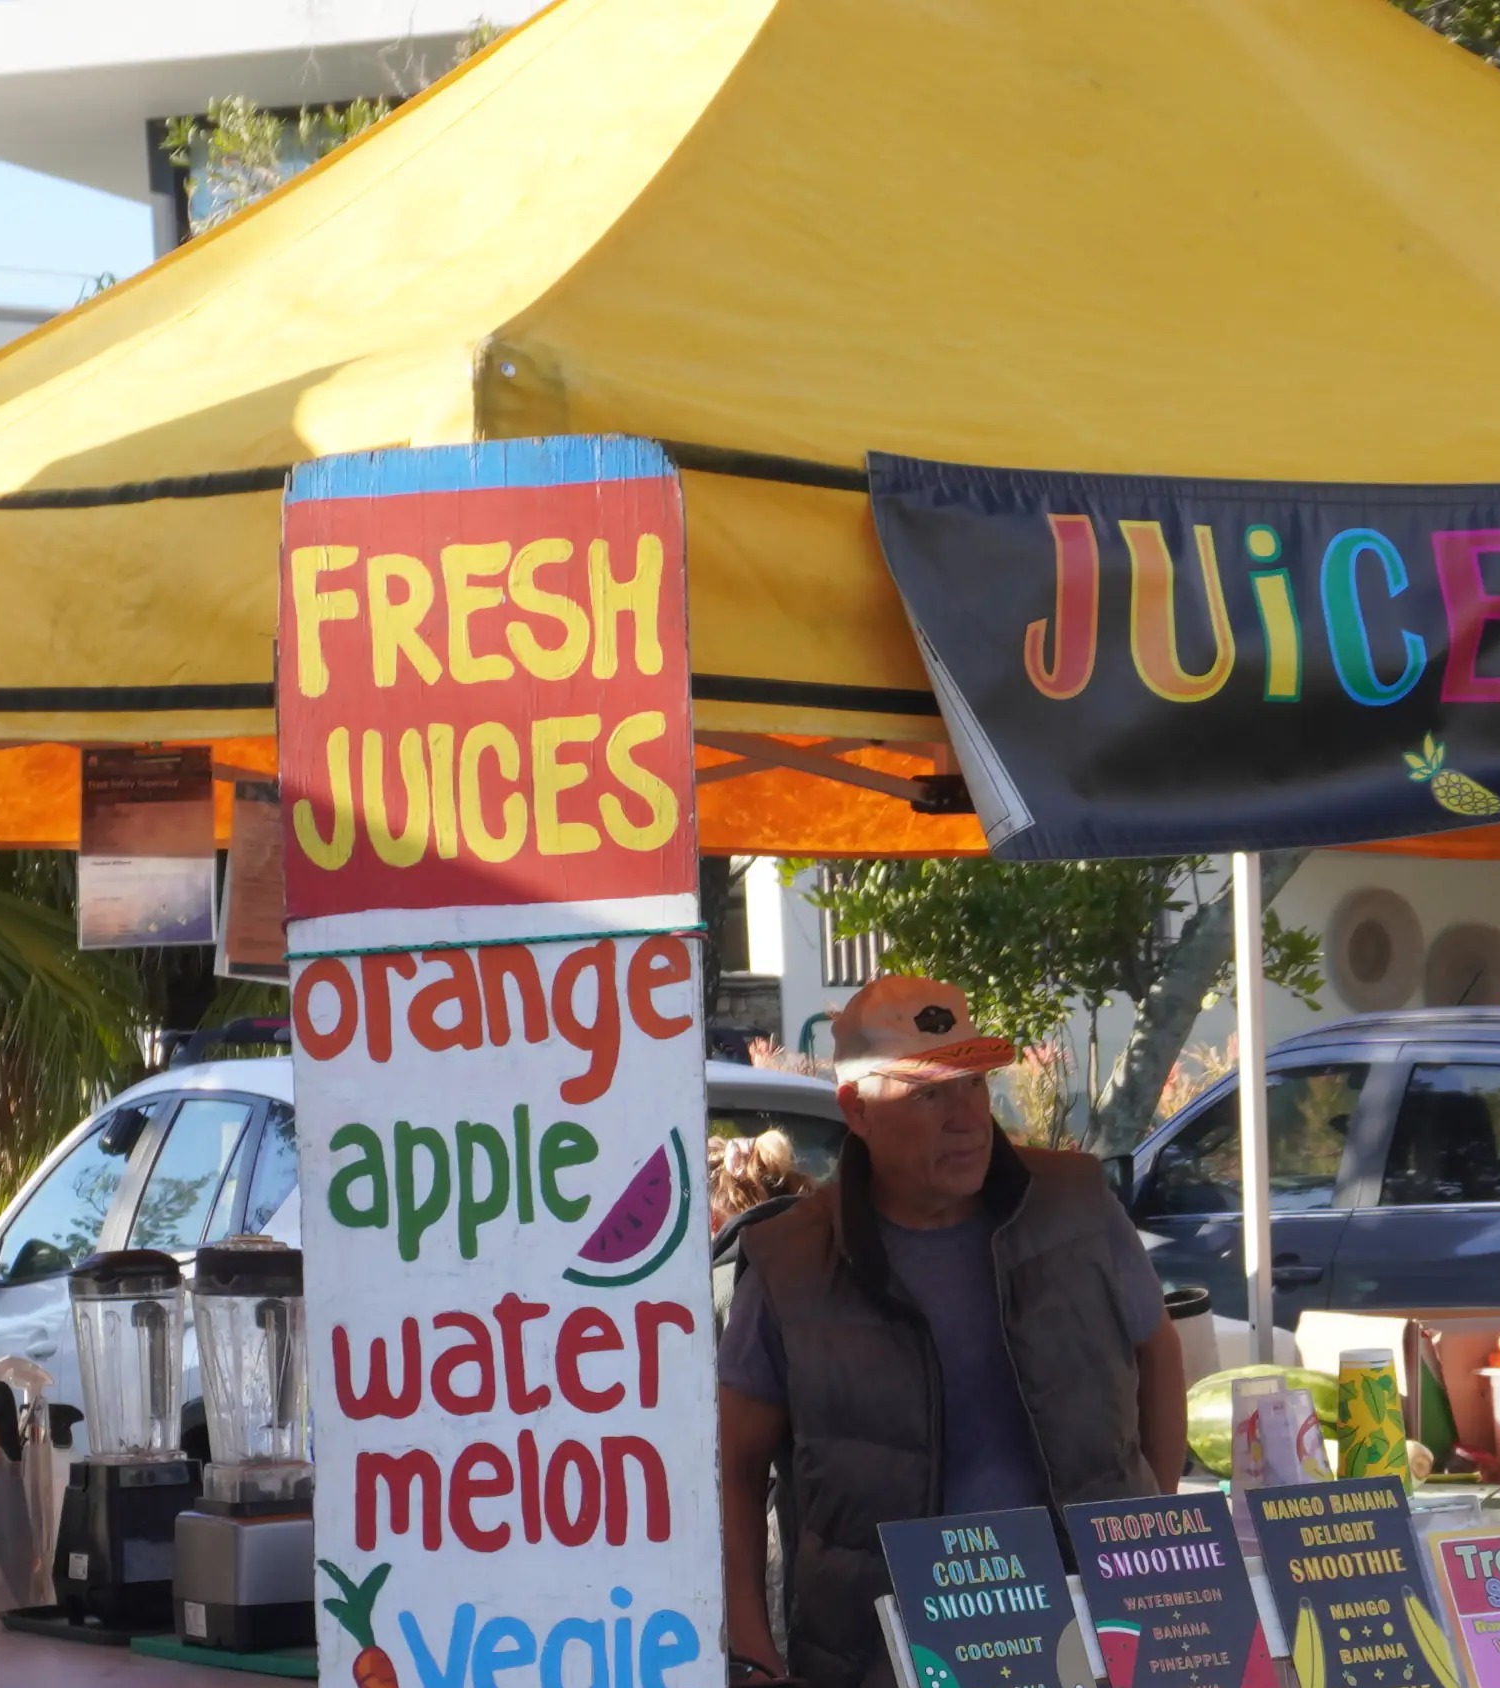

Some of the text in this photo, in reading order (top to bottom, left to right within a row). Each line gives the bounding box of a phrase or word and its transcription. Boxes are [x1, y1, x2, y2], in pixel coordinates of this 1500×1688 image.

[290, 533, 665, 698] FRESH
[291, 709, 679, 871] JUICES
[291, 934, 693, 1105] orange
[328, 1103, 599, 1262] apple
[331, 1292, 696, 1420] water
[354, 1428, 671, 1553] melon
[1262, 1488, 1399, 1521] MANGO BANANA
[941, 1526, 1000, 1555] PINA
[1090, 1507, 1212, 1544] TROPICAL
[1300, 1520, 1376, 1547] DELIGHT
[932, 1554, 1026, 1588] COLADA
[1097, 1541, 1226, 1580] SMOOTHIE
[1289, 1548, 1407, 1584] SMOOTHIE
[923, 1584, 1052, 1622] SMOOTHIE
[1123, 1588, 1223, 1611] WATERMELON
[1329, 1599, 1391, 1620] MANGO
[1152, 1621, 1211, 1641] BANANA
[955, 1636, 1043, 1662] COCONUT
[1149, 1651, 1231, 1674] PINEAPPLE
[1338, 1642, 1408, 1665] BANANA
